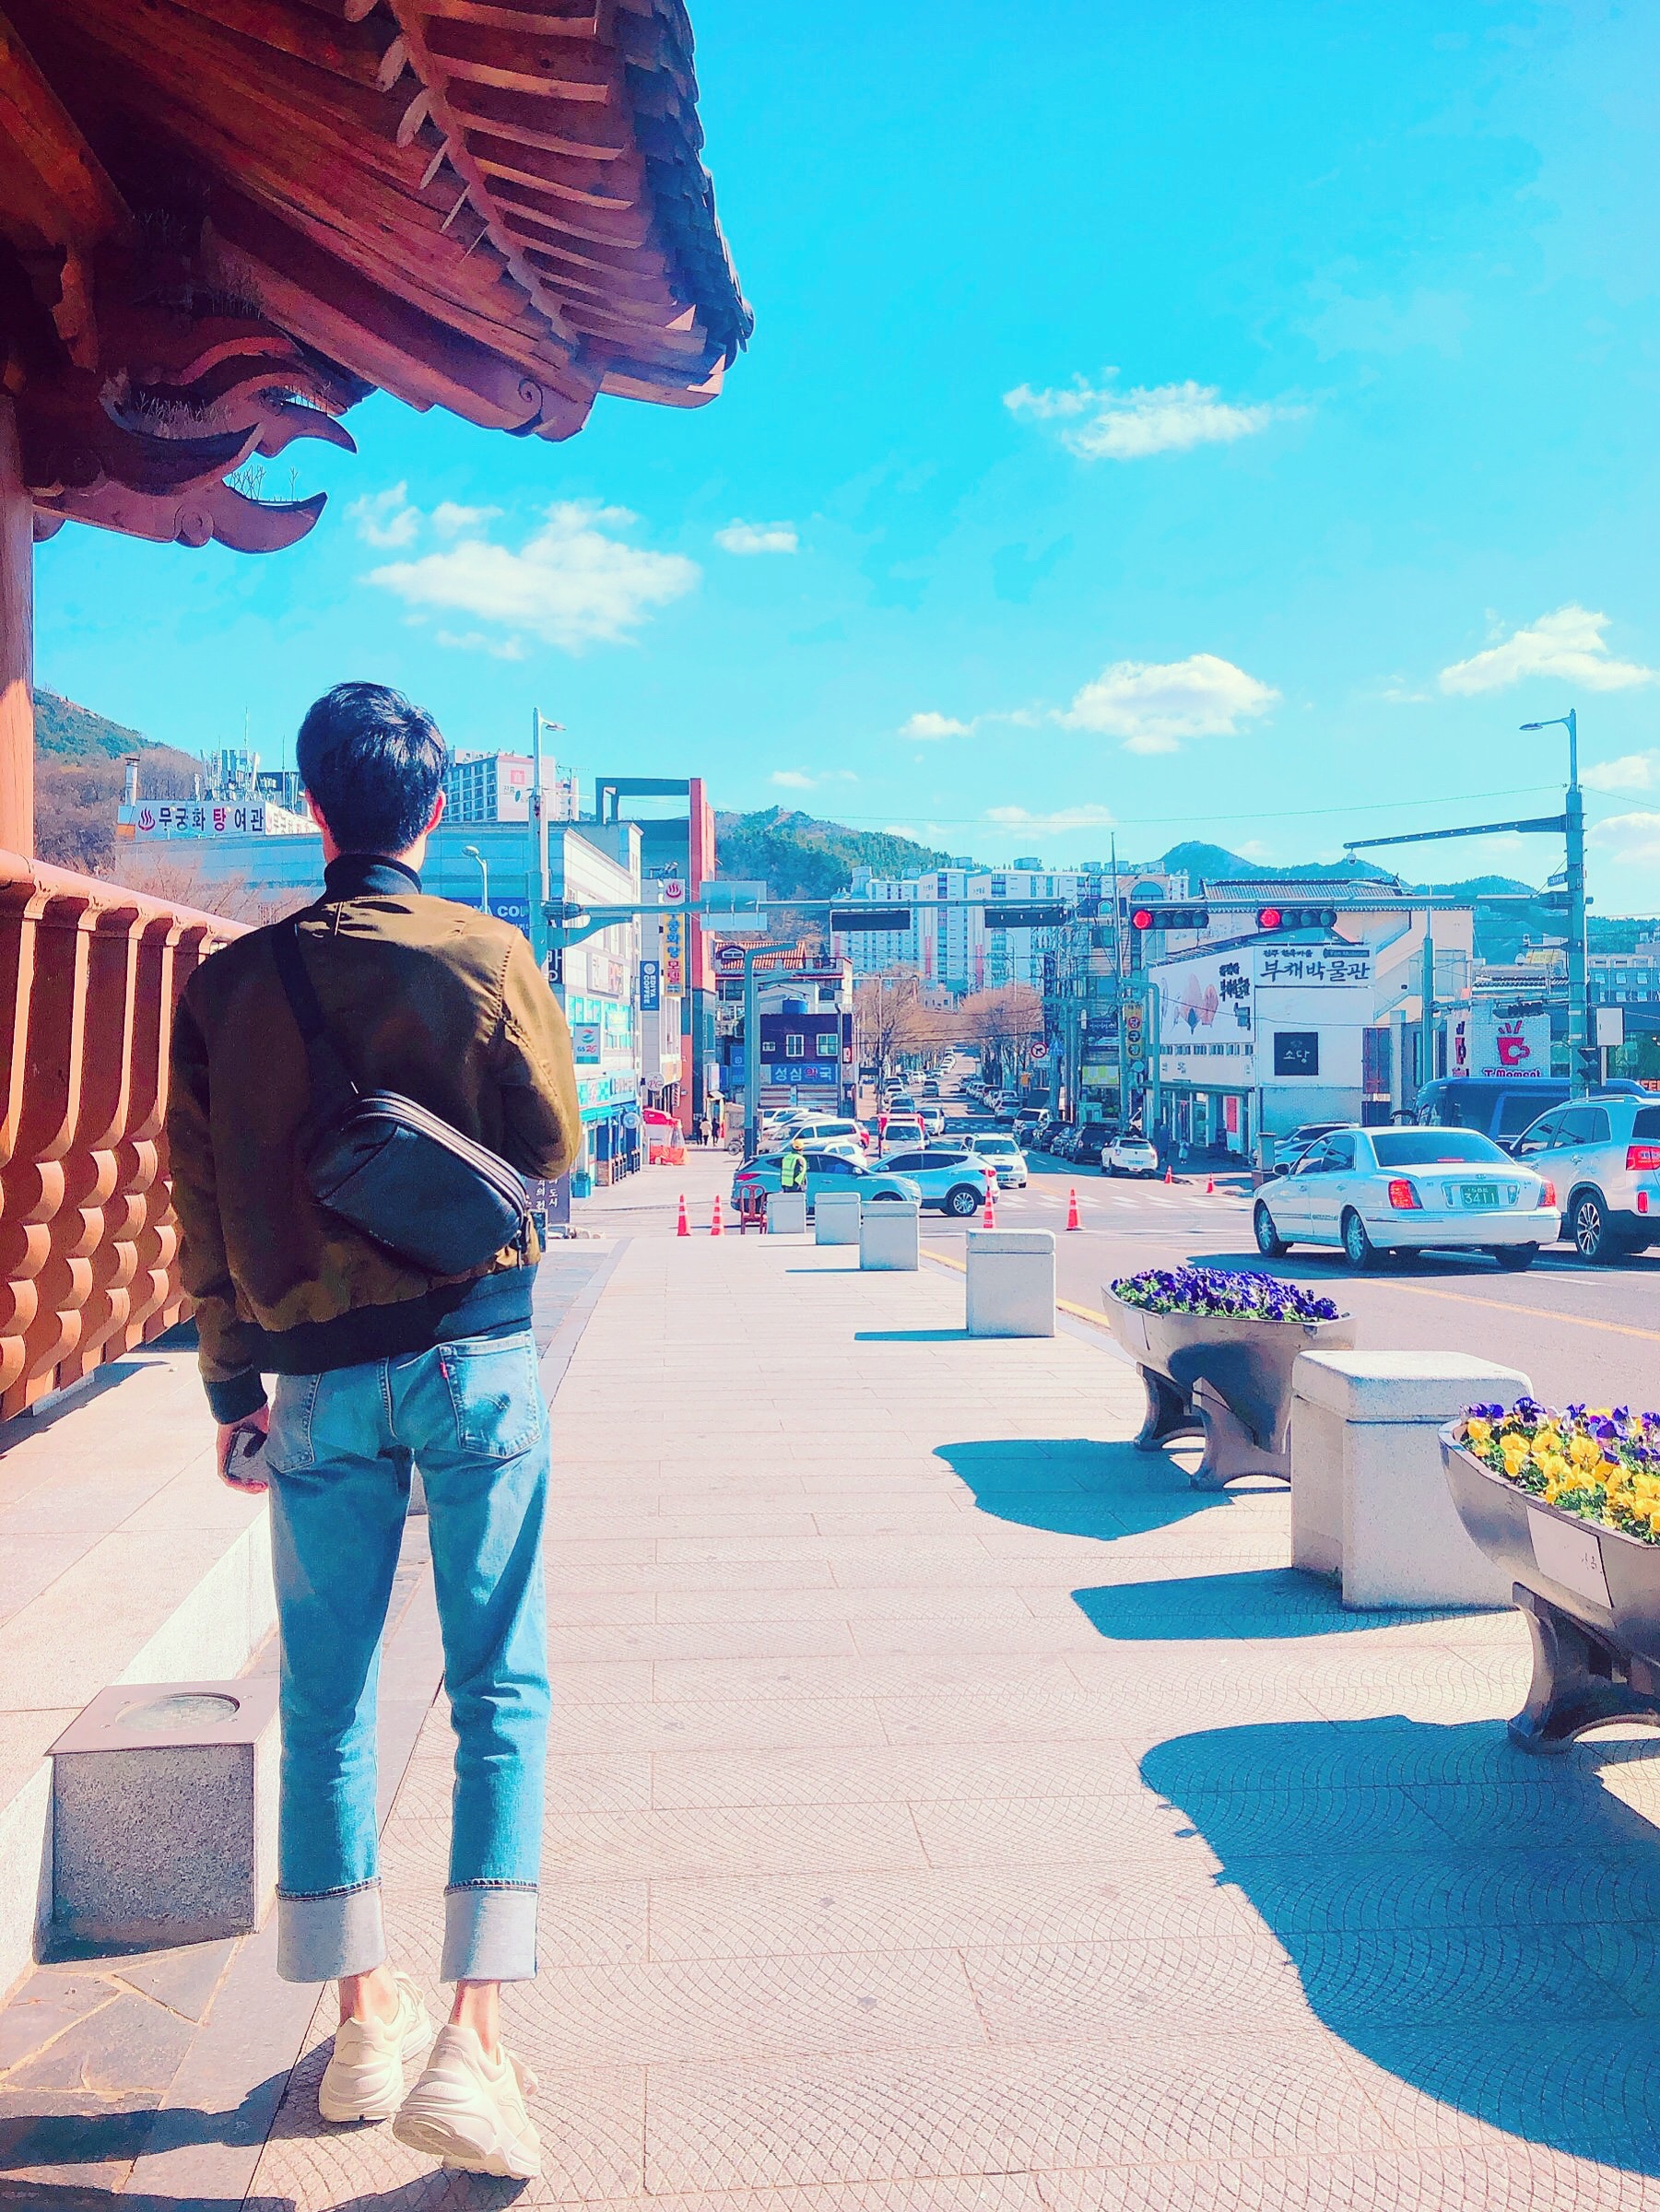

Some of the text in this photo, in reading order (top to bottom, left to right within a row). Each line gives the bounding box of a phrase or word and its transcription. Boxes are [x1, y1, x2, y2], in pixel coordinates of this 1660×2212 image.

[159, 806, 206, 831] 무궁화
[213, 807, 227, 832] 탕
[234, 808, 265, 832] 여관
[1260, 959, 1371, 982] 부채박물관
[1282, 1050, 1311, 1064] 소당
[774, 1066, 832, 1081] 성심약국
[1464, 1193, 1496, 1205] 3411
